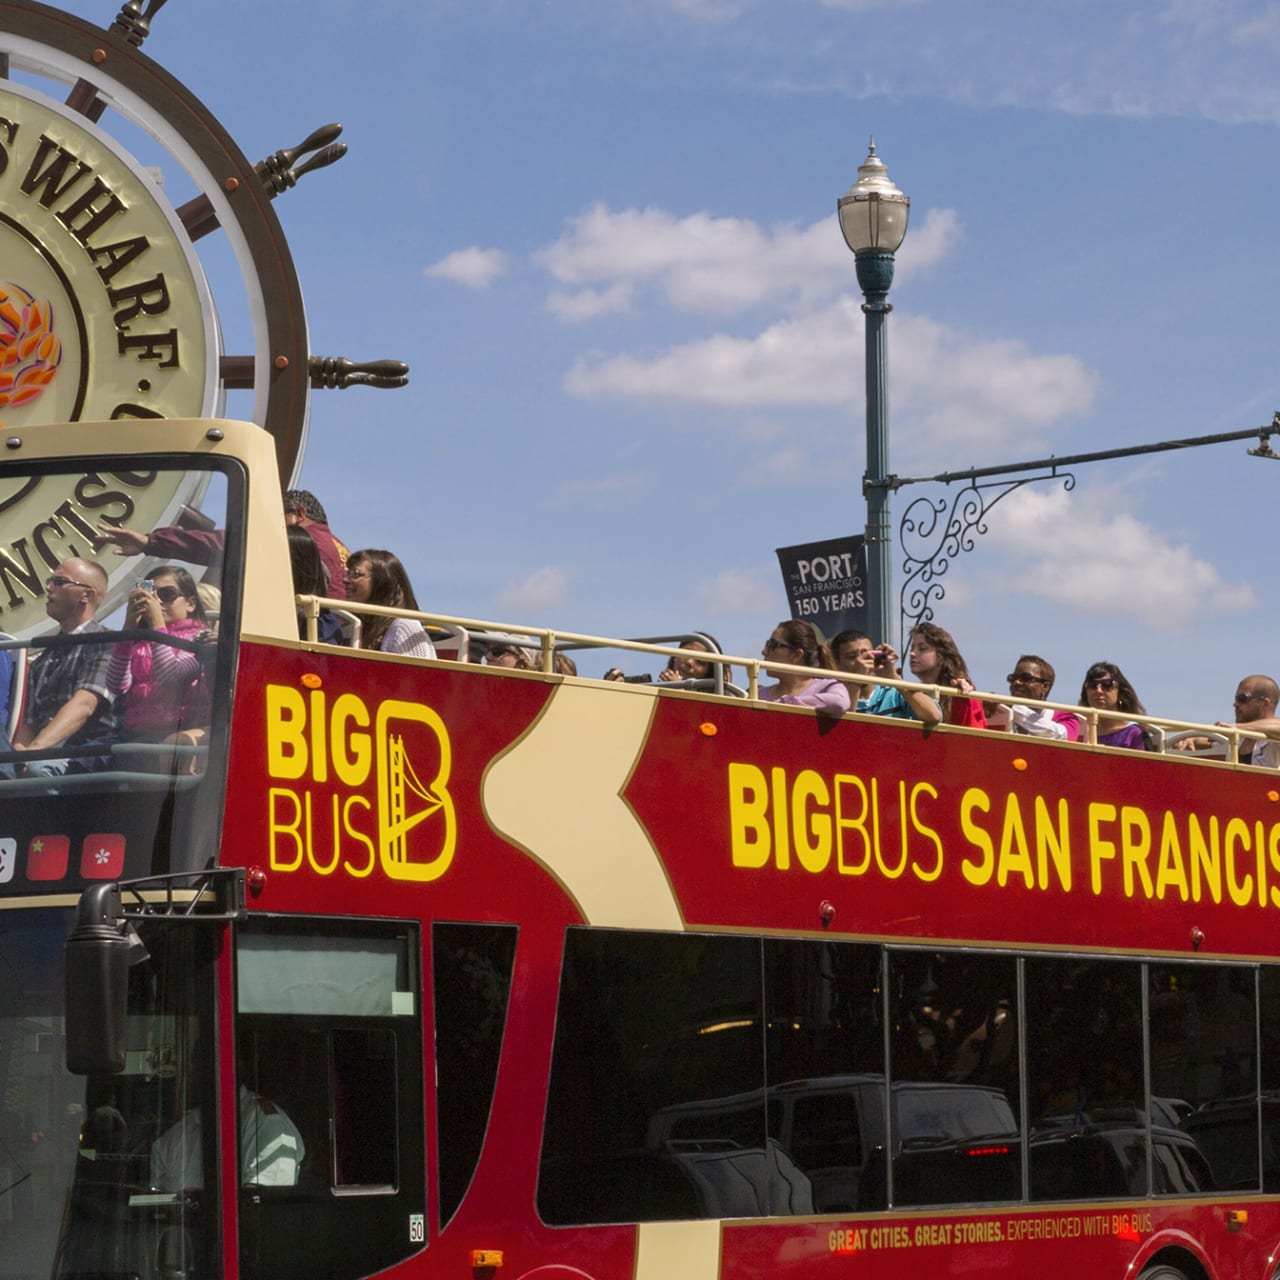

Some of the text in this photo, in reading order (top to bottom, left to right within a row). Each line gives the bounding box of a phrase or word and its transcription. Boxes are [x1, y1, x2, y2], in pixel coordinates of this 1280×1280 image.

[18, 133, 181, 371] WHARF
[792, 576, 862, 596] SAN FRANCISCO
[797, 552, 852, 585] PORT
[795, 590, 865, 616] 150 YEARS
[266, 684, 372, 787] BIG
[268, 787, 376, 879] BUS
[960, 787, 1072, 893] SAN
[411, 1221, 423, 1240] 50
[828, 1212, 1154, 1252] GREAT CITIES. GREAT STORIES. EXPERIENCED WITH BIG BUS.
